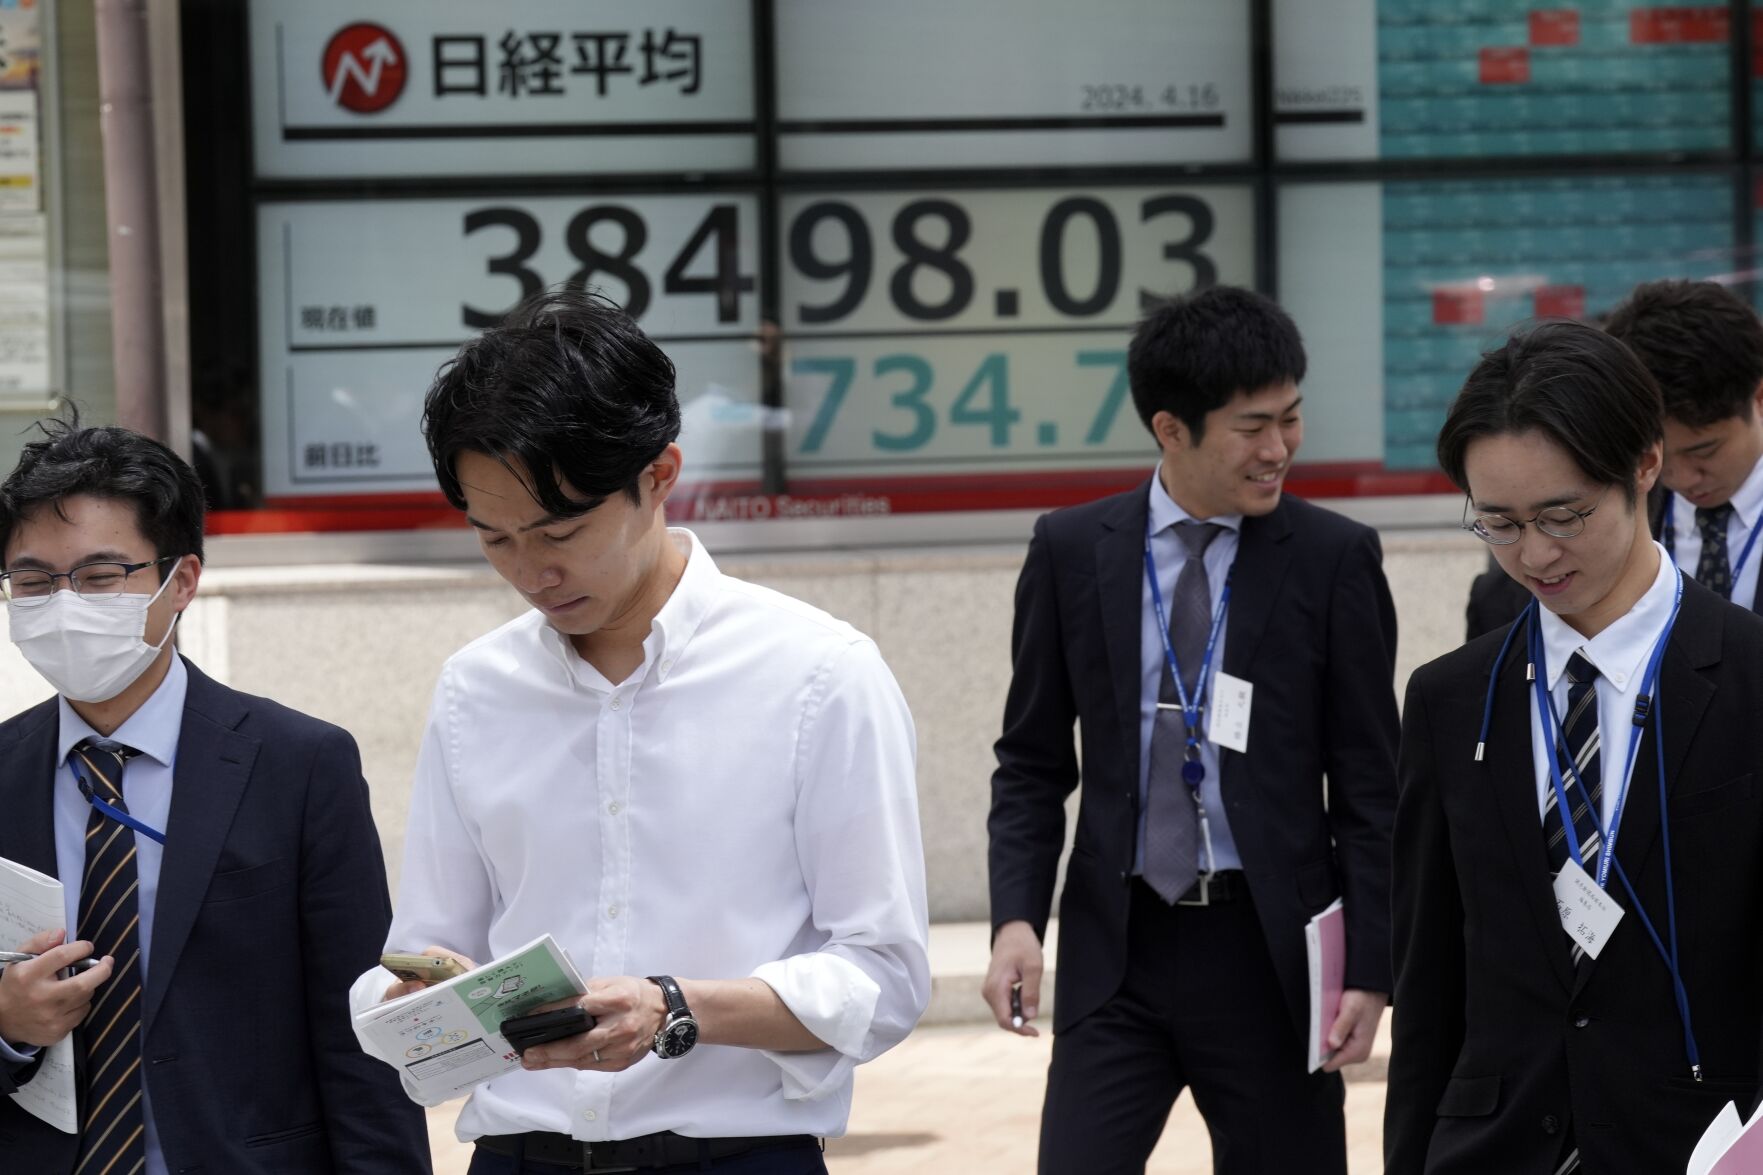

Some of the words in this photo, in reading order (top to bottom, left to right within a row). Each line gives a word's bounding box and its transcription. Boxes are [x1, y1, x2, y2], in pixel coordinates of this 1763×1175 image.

[432, 29, 703, 98] 日経平均
[776, 493, 891, 518] Securities
